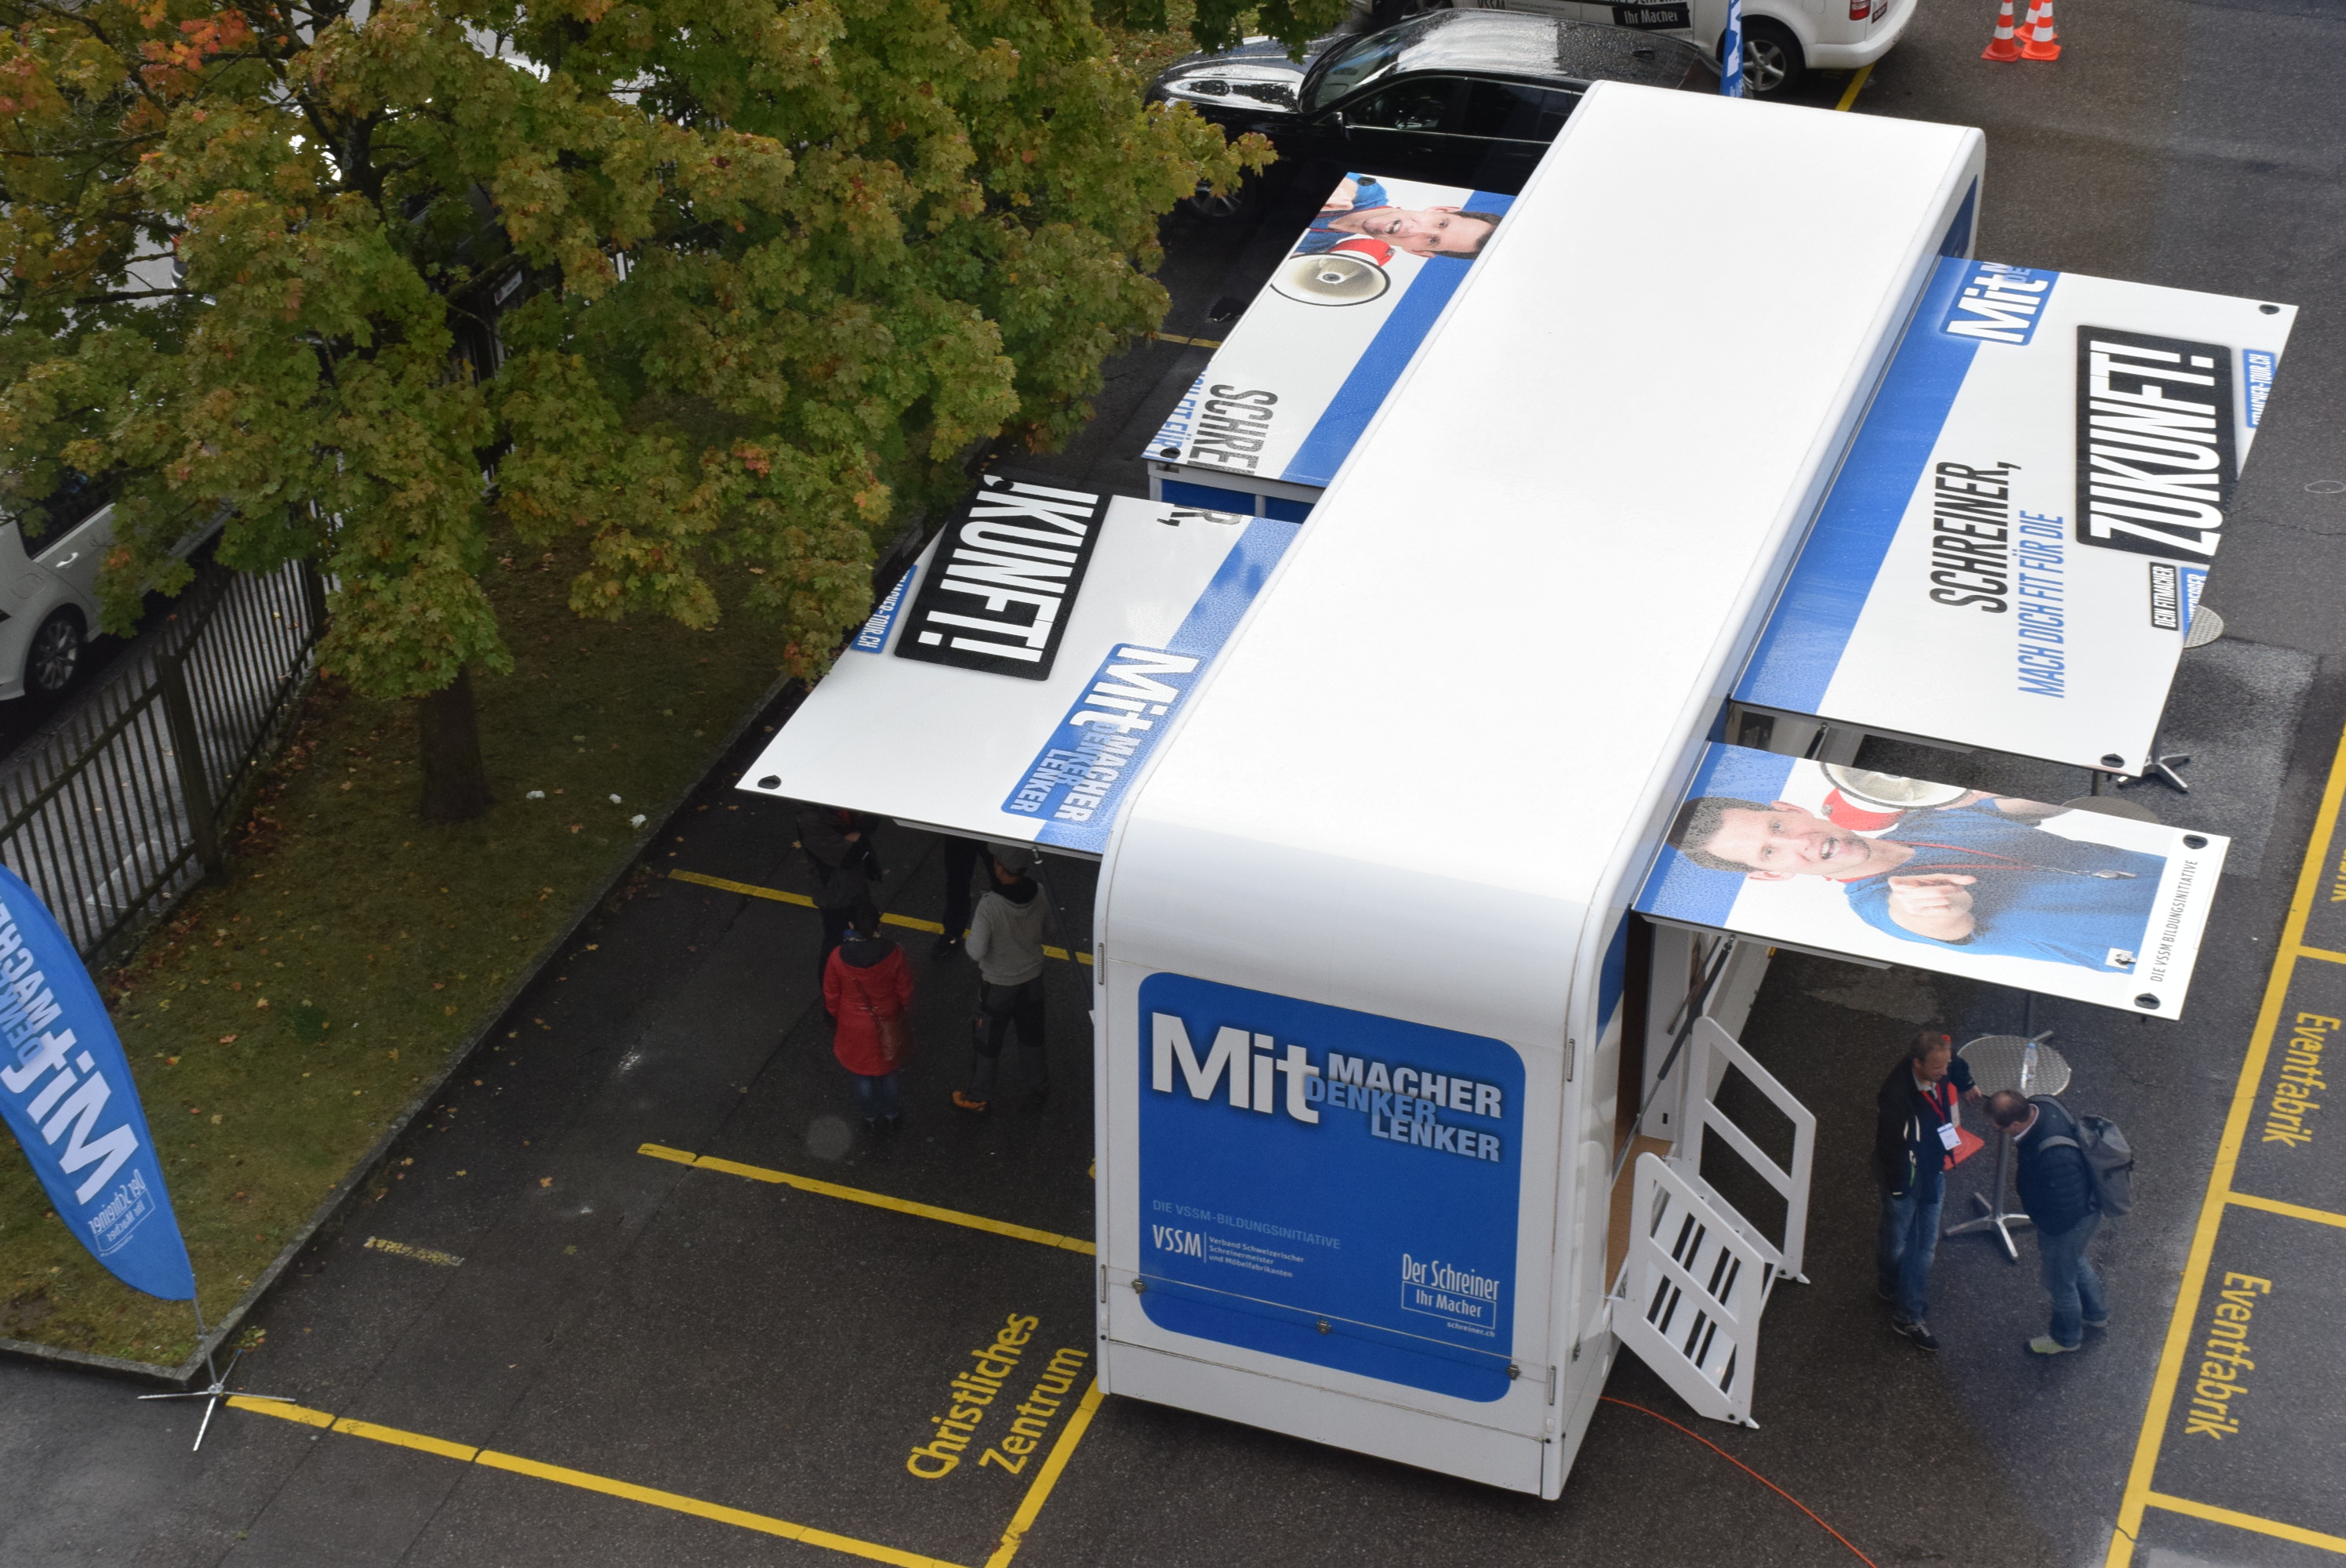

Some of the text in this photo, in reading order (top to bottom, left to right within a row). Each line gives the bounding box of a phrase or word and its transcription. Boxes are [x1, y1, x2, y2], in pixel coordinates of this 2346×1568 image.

[1624, 10, 1639, 24] Ihr
[1946, 274, 2049, 343] Mit
[2090, 340, 2223, 556] ZUKUNFT!
[1930, 461, 2021, 613] SCHREINER,
[2011, 510, 2065, 699] MACH DICH FIT FÜR DIE
[2152, 566, 2177, 628] DEIN FITMACHER
[1069, 647, 1200, 734] Mit
[1010, 748, 1072, 813] LENKER
[1054, 721, 1119, 787] DENKER
[1054, 734, 1142, 822] MACHER
[2150, 859, 2198, 982] DIE VSSM BILDUNGSINITIATIVE
[1152, 1011, 1319, 1124] Mit
[1328, 1052, 1502, 1119] MACHER
[2261, 1012, 2342, 1148] Eventfabrik
[1305, 1075, 1436, 1127] DENKER
[1371, 1112, 1500, 1162] LENKER
[1153, 1200, 1341, 1250] DIE VSSM-BILDUNGSINITIATIVE
[1153, 1225, 1202, 1258] VSSM
[1209, 1236, 1304, 1263] Verband Schweizerischer
[1209, 1245, 1274, 1265] Schreinermeister
[1209, 1254, 1293, 1278] und Möbelfabrikanten
[1402, 1254, 1500, 1301] Der Schreiner
[1416, 1289, 1482, 1318] Ihr Macher
[1447, 1322, 1495, 1338] schreiner.ch
[2184, 1271, 2272, 1440] Eventfabrik
[906, 1312, 1040, 1479] Christliches
[978, 1347, 1089, 1475] Zentrum
